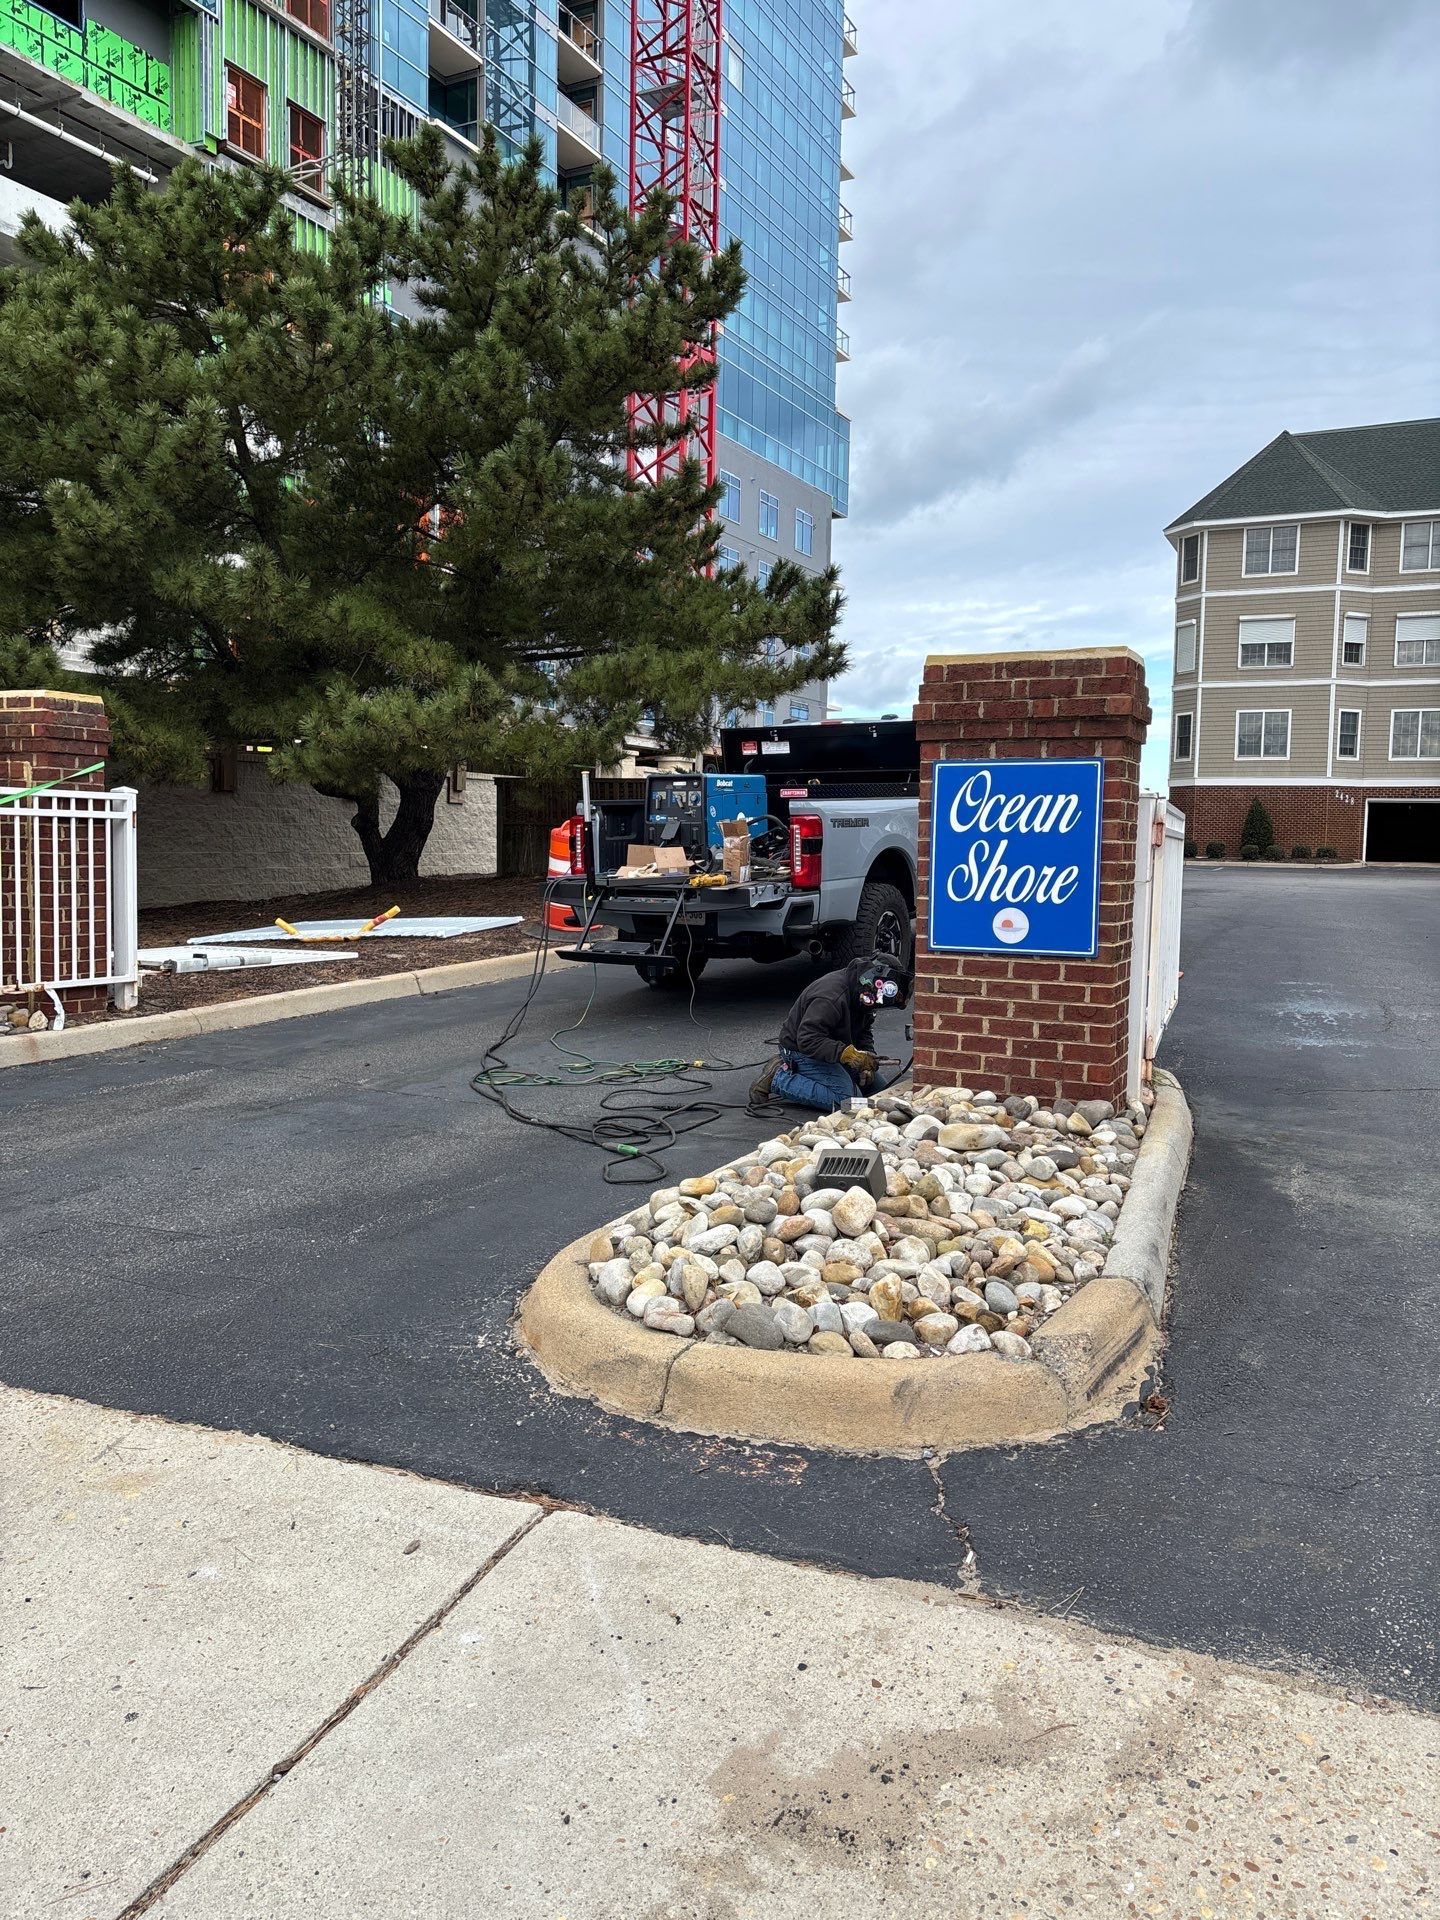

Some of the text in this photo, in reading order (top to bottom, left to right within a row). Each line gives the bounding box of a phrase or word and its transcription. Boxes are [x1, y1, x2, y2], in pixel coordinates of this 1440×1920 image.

[716, 779, 733, 787] Bobcat
[950, 770, 1082, 833] Ocean
[830, 818, 870, 828] TREMOR
[947, 839, 1079, 904] Shore
